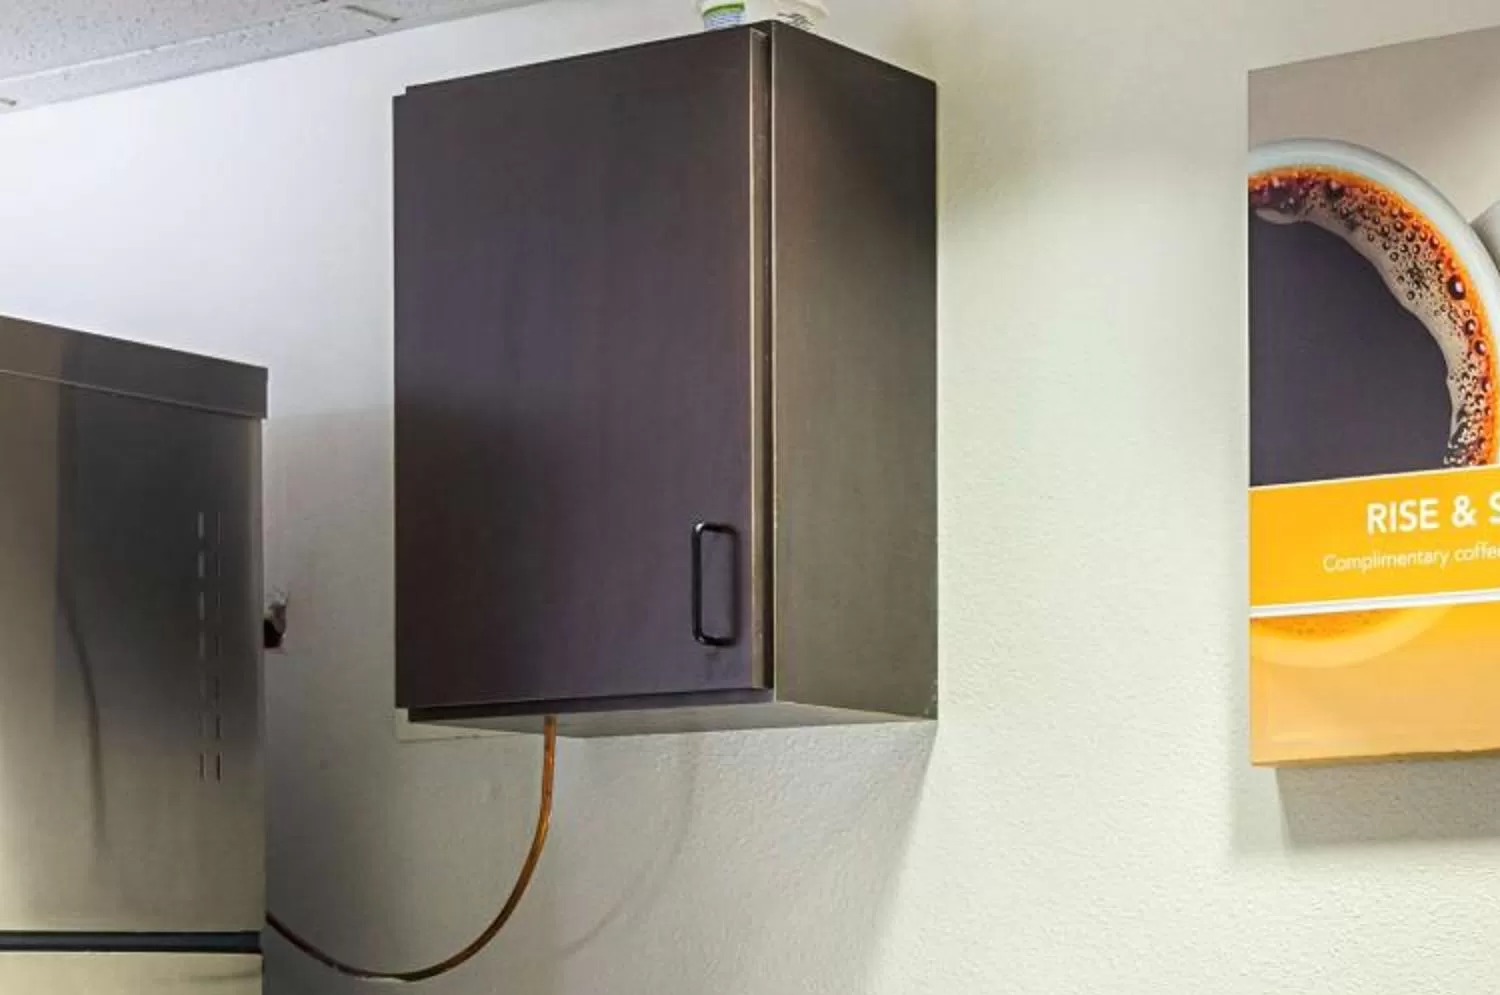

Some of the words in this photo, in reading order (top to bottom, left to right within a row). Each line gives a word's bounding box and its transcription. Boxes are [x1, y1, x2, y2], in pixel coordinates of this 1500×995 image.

[1366, 497, 1440, 535] RISE
[1451, 495, 1478, 528] &
[1322, 549, 1450, 574] Complimentary
